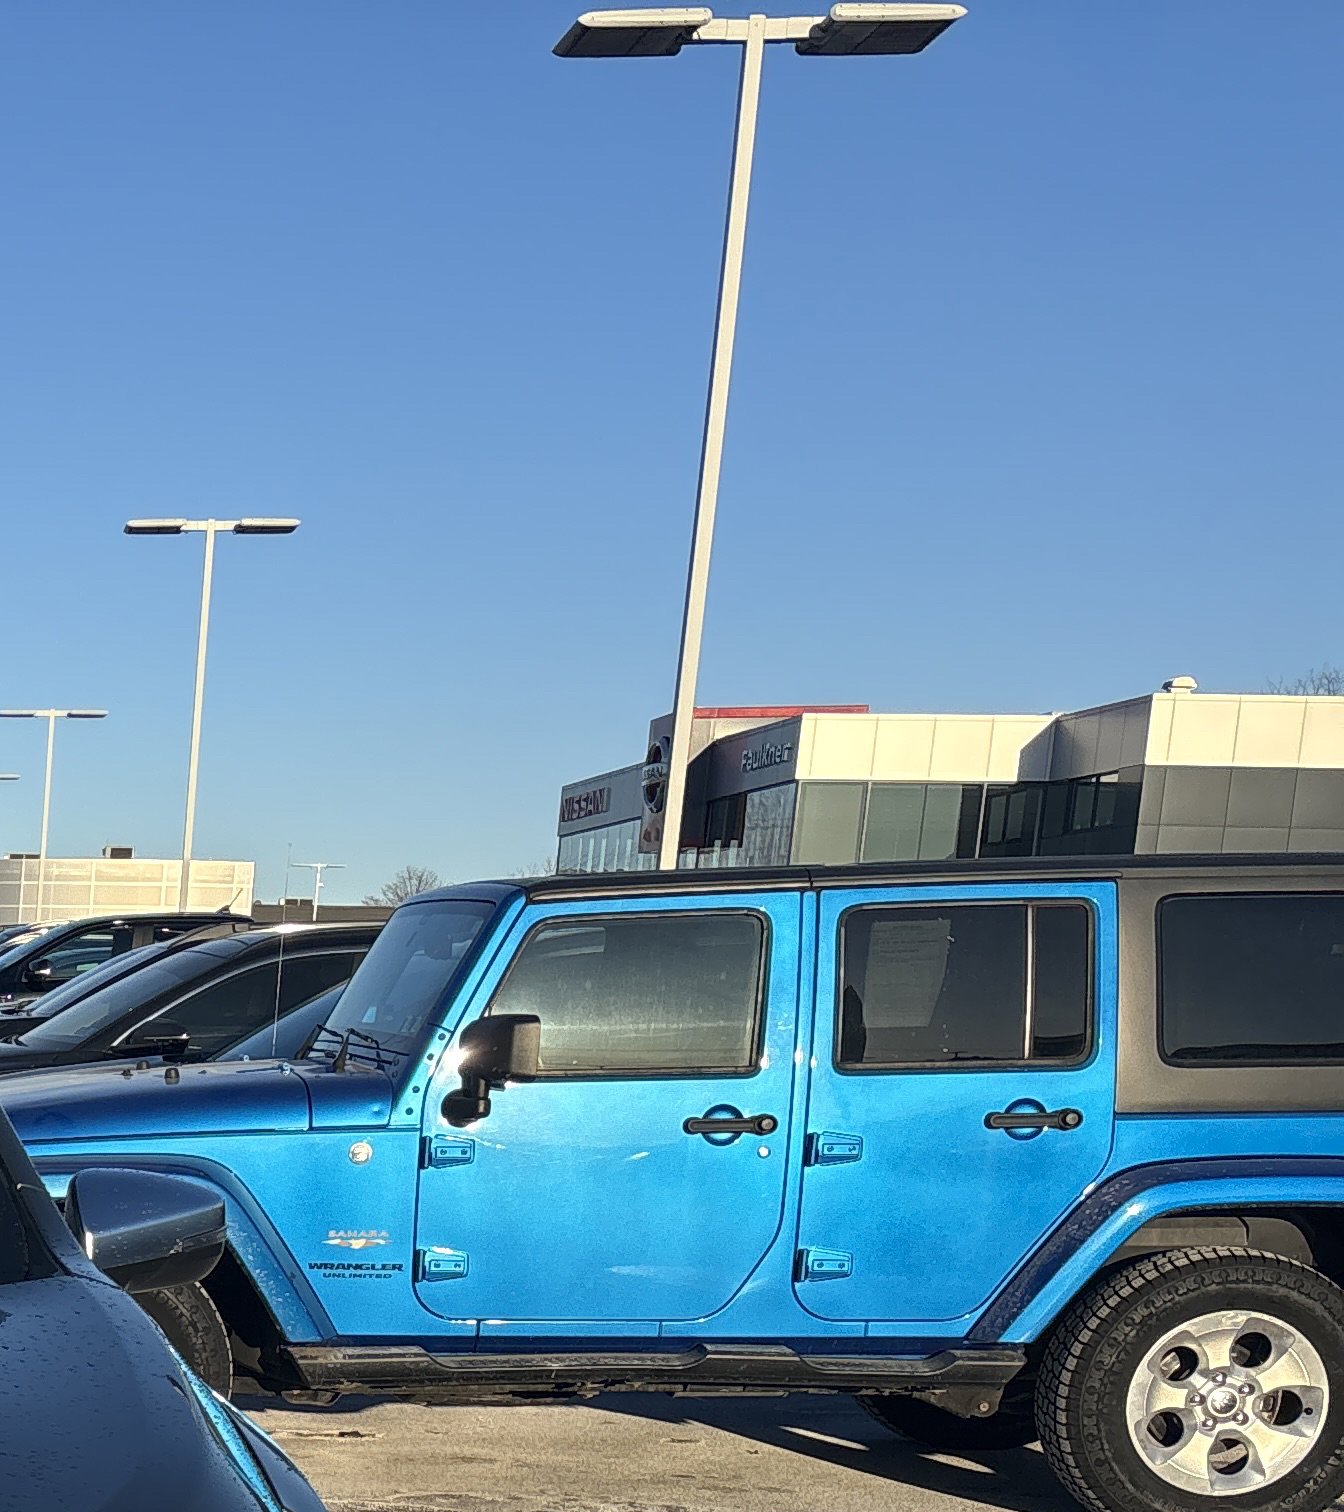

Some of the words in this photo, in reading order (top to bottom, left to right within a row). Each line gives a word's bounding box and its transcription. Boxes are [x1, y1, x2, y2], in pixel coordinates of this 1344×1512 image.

[741, 743, 792, 772] Faulkner
[561, 787, 610, 822] NISSAN
[328, 1229, 389, 1238] SAHARA
[308, 1262, 404, 1272] WRANGLER
